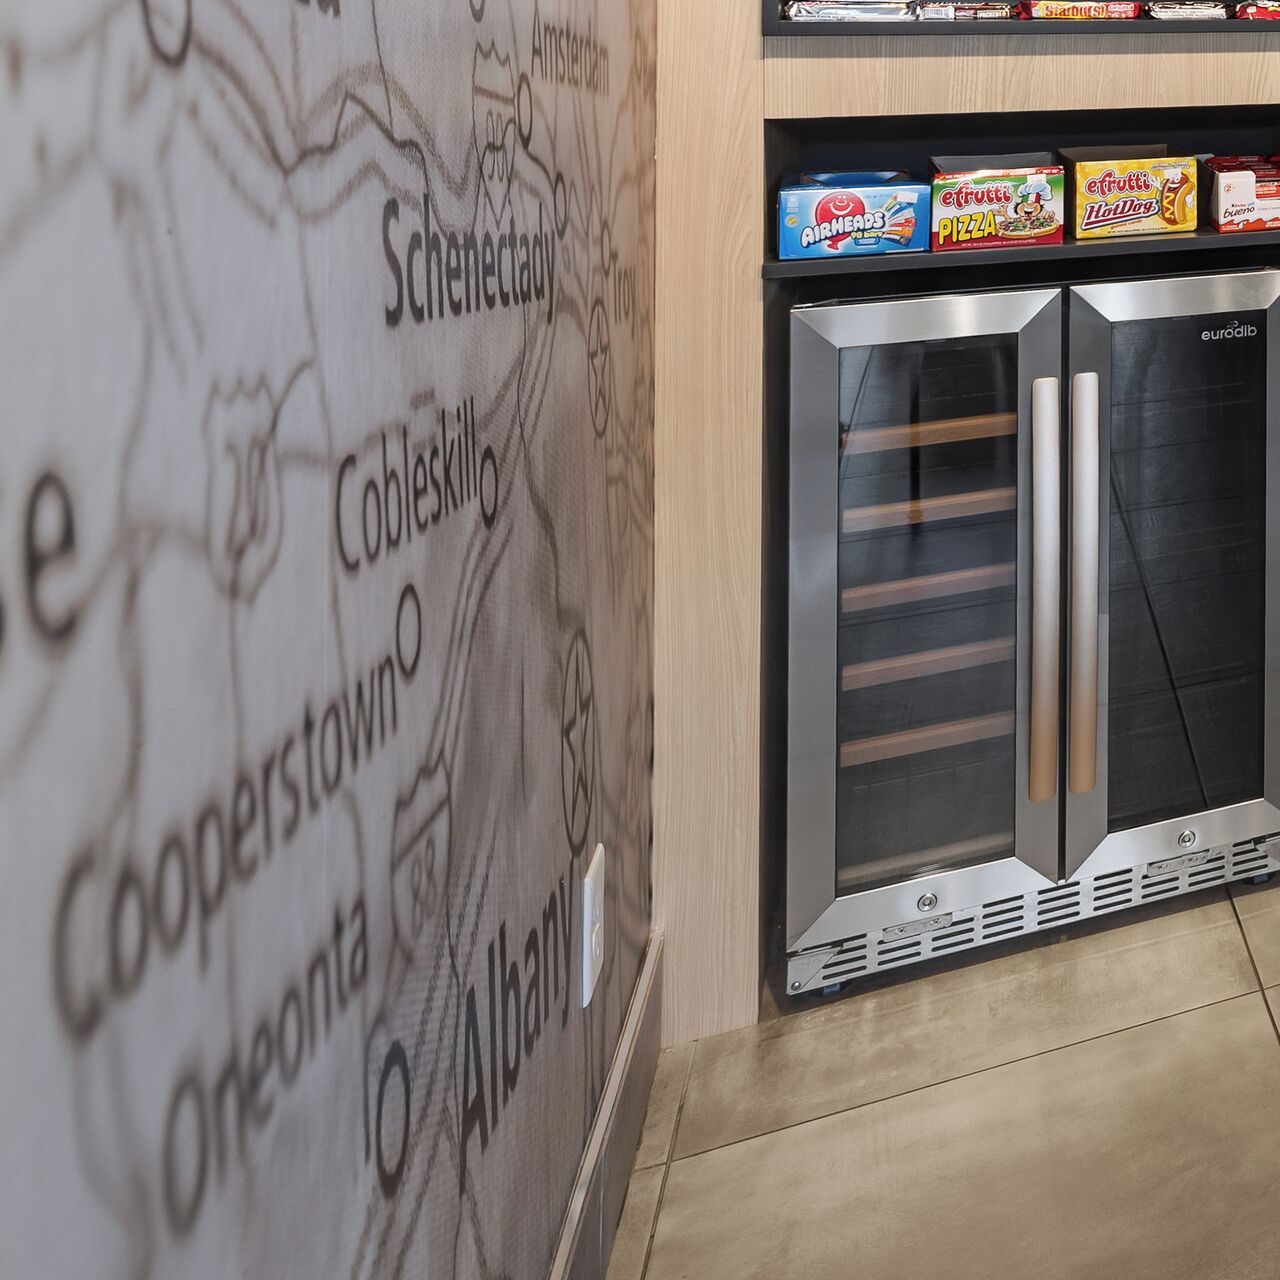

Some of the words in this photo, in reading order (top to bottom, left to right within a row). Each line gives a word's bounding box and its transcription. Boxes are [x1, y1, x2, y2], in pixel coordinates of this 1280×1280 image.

[940, 181, 1012, 208] efrutti
[1086, 170, 1151, 197] efrutti
[801, 211, 886, 247] AIRHEADS
[939, 211, 997, 245] PIZZA
[1223, 206, 1255, 219] bueno
[851, 231, 864, 240] 90
[864, 230, 884, 239] bars
[382, 193, 555, 328] Schenectady
[611, 251, 636, 340] Troy
[1201, 324, 1257, 340] eurodib
[335, 396, 478, 574] Cobleskill
[53, 655, 398, 1048] Cooperstown
[459, 866, 575, 1199] Albany
[161, 896, 369, 1248] Oneonta
